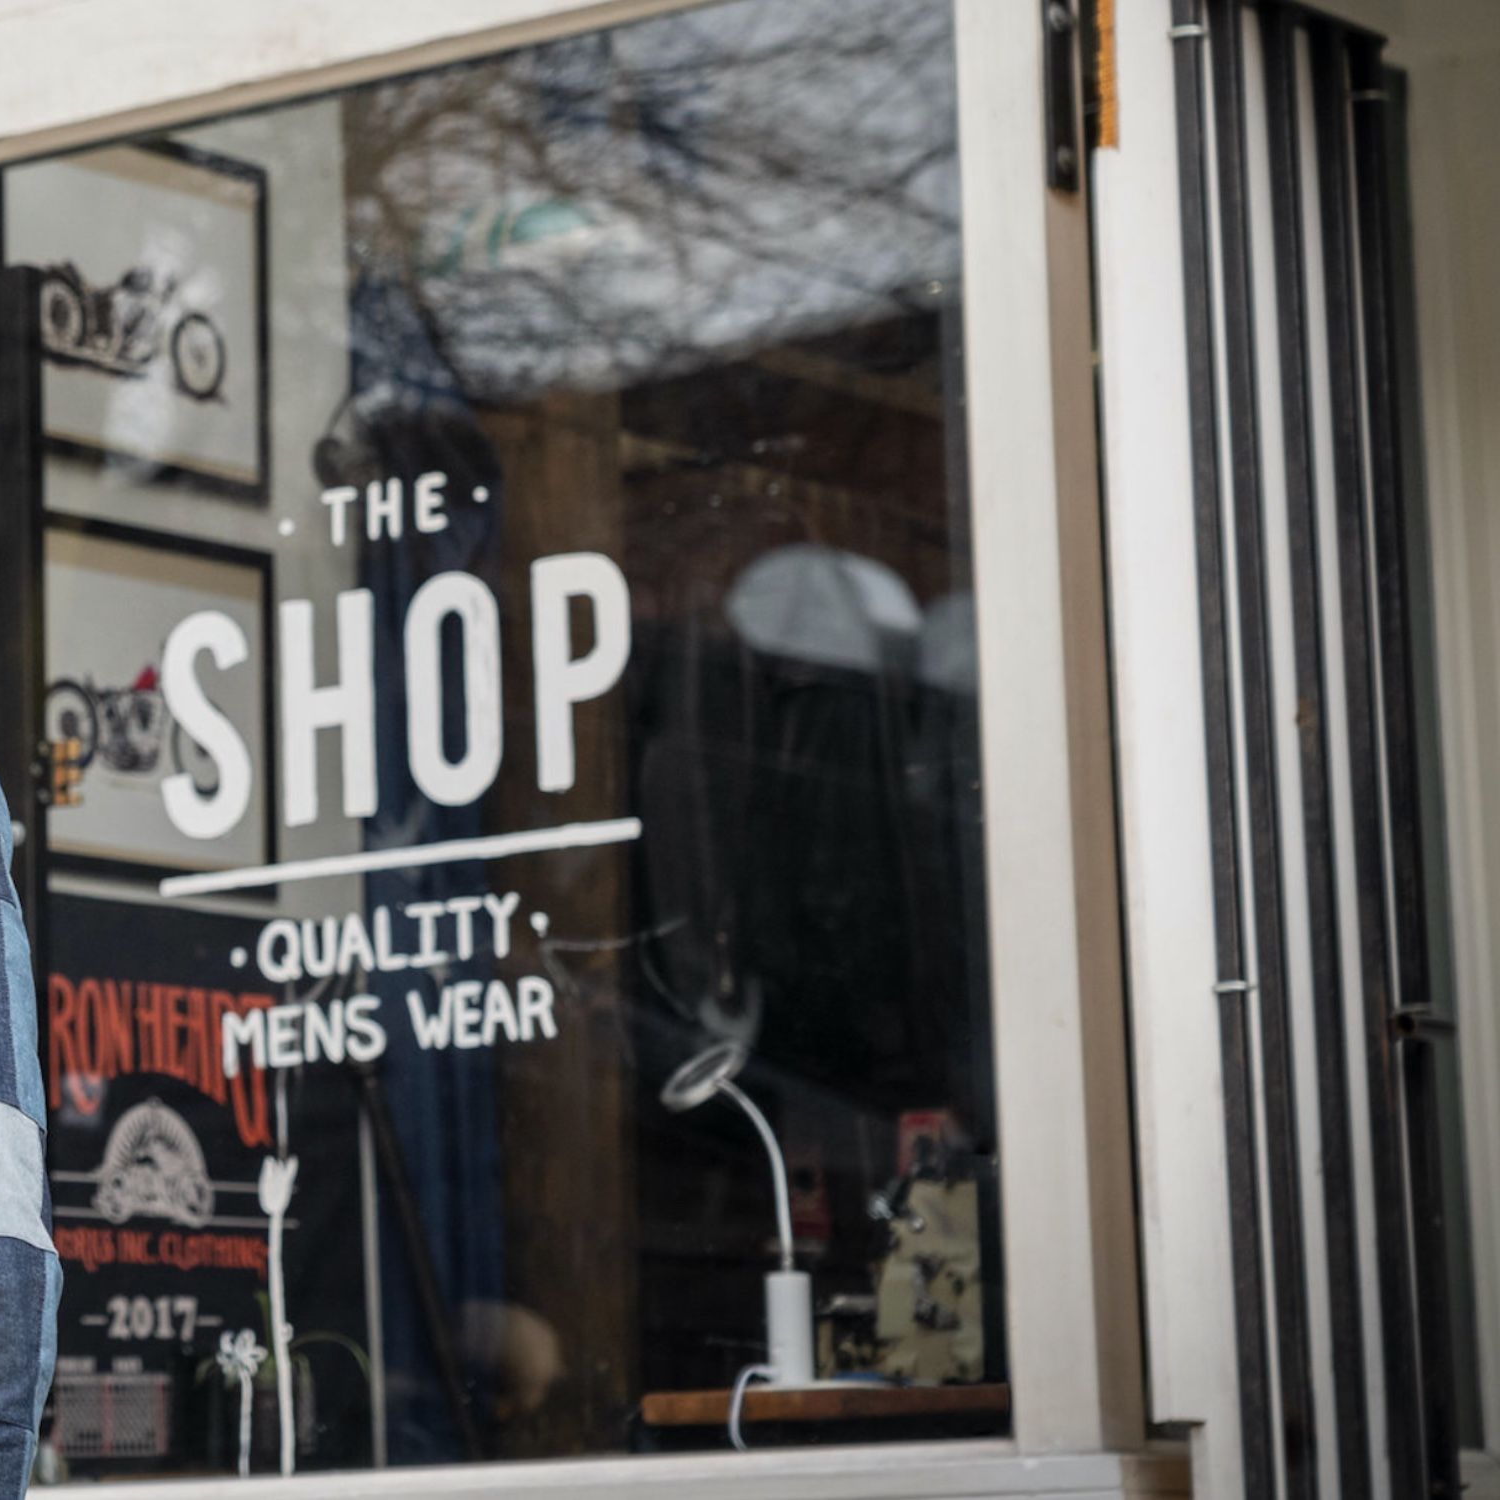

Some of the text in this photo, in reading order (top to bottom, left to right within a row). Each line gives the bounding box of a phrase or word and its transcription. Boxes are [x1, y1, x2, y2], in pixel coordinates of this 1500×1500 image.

[320, 470, 449, 547] THE
[160, 551, 632, 840] SHOP
[256, 890, 521, 983] QUALITY
[220, 976, 558, 1079] MENS WEAR
[106, 1294, 199, 1343] 2017
